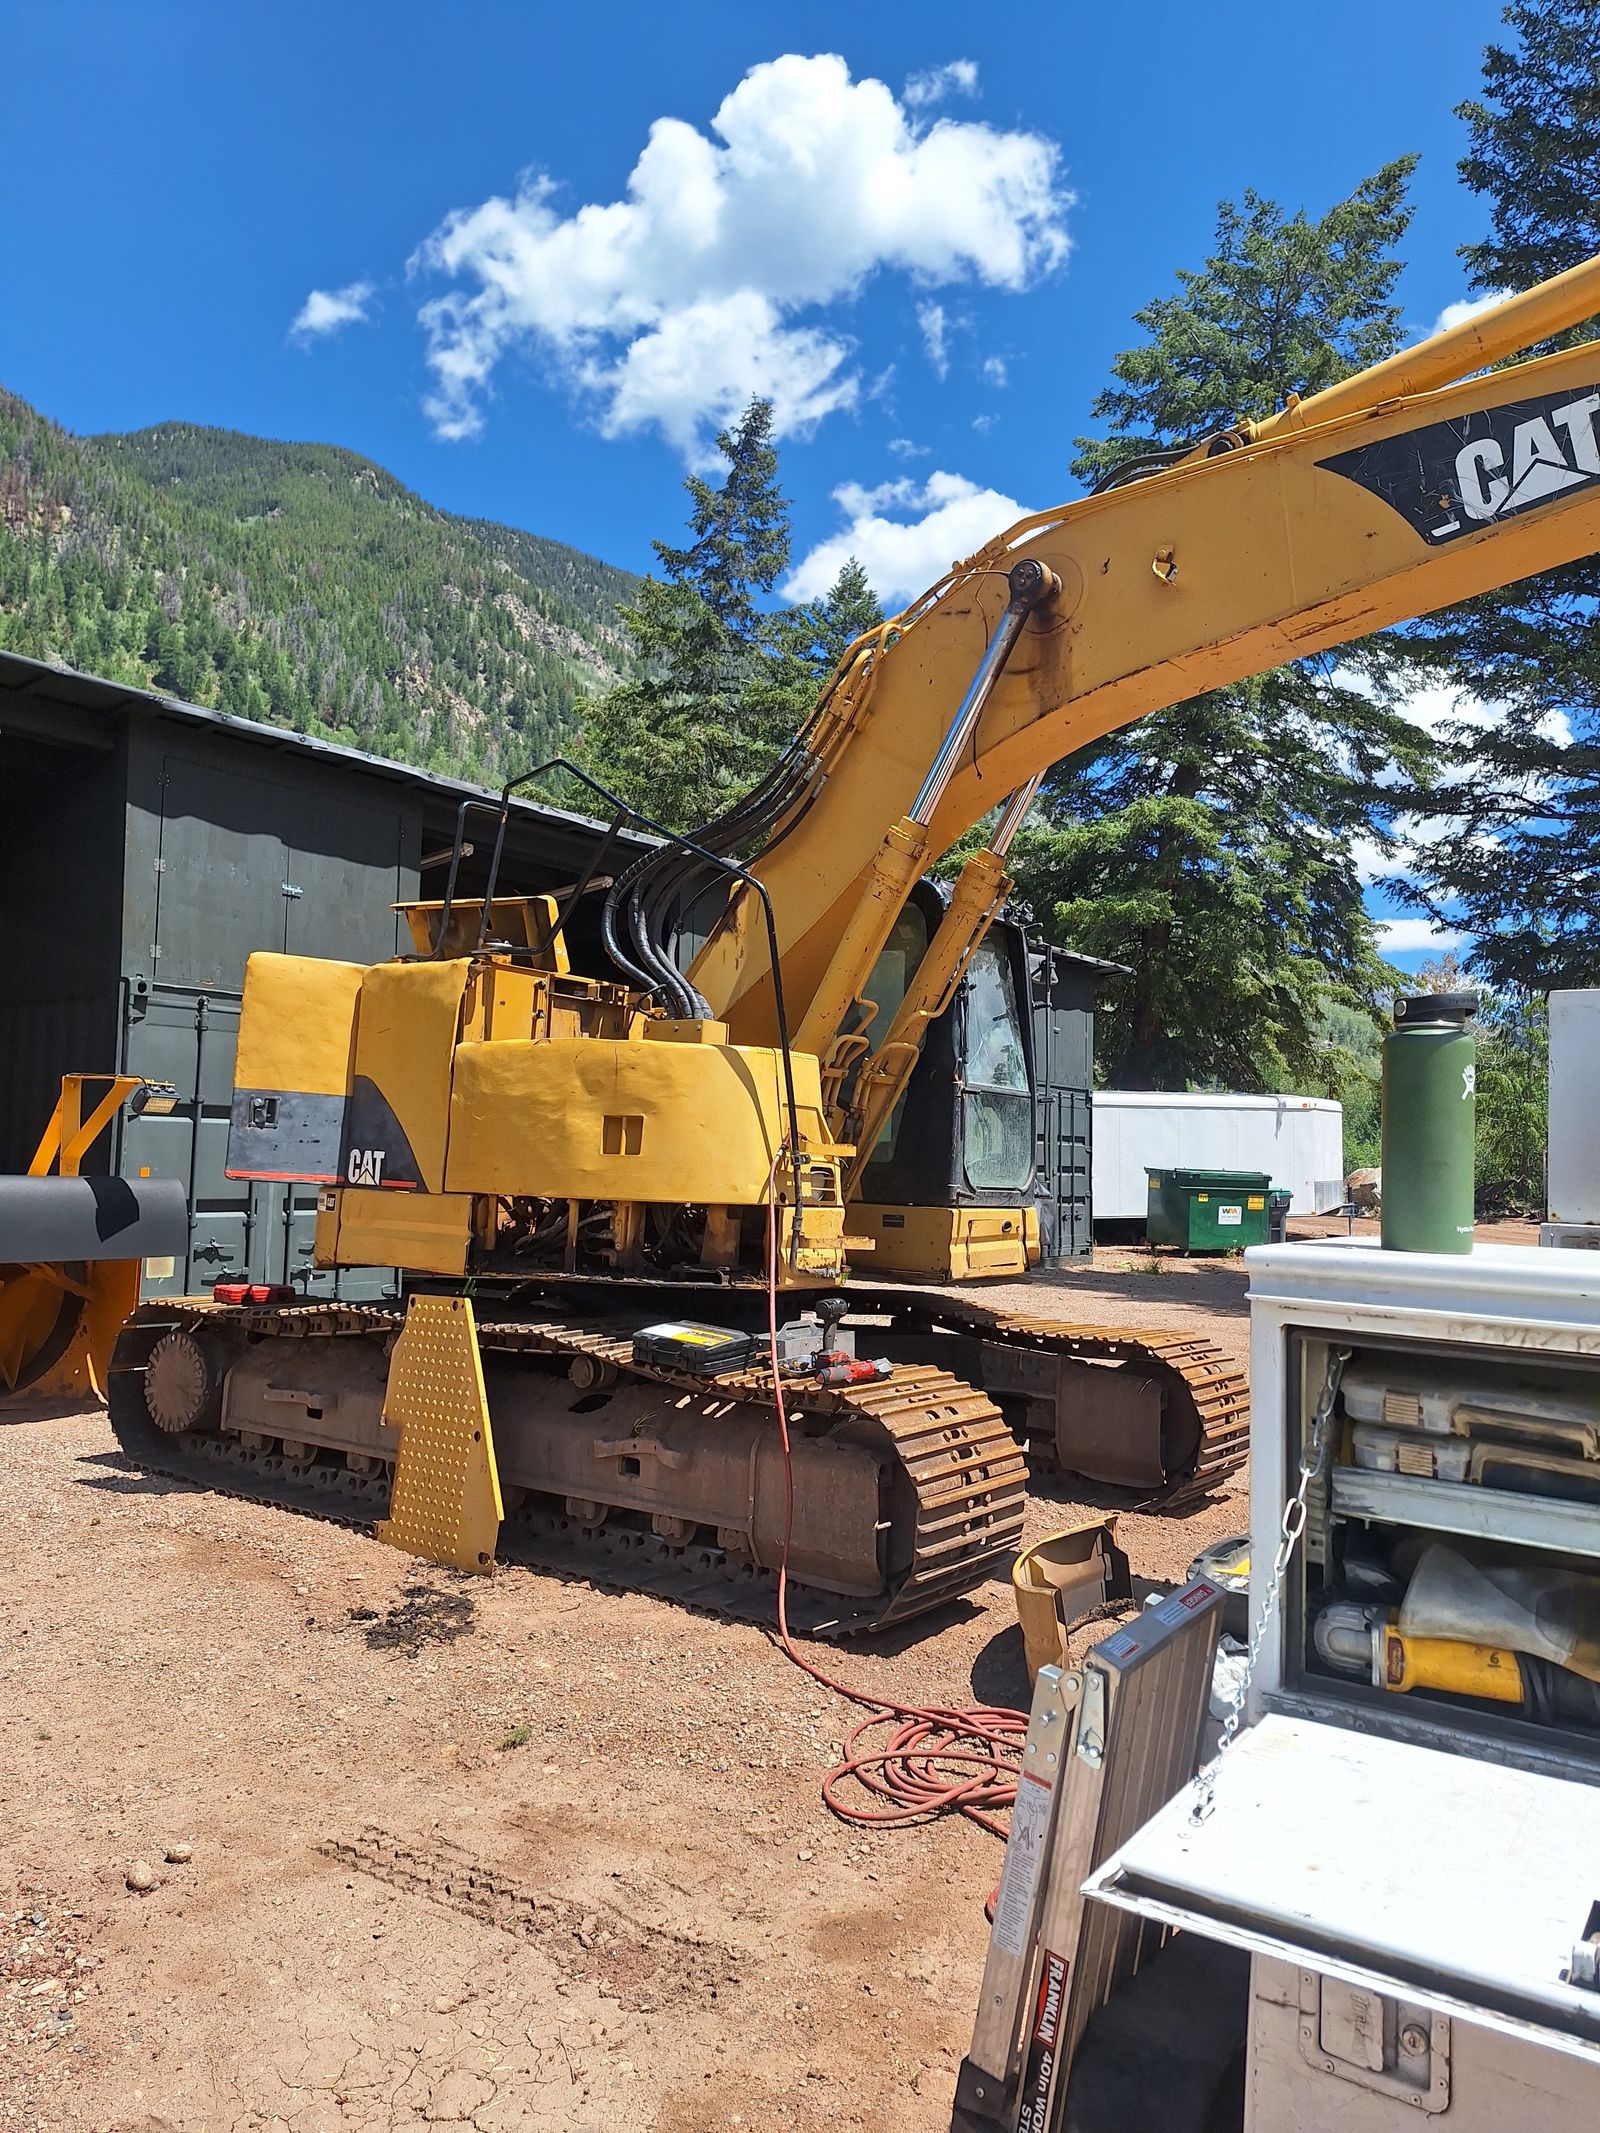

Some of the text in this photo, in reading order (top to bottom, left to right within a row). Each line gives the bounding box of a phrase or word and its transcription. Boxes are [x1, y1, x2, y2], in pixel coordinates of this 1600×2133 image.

[1455, 392, 1600, 521] CAT
[347, 1148, 386, 1186] CAT
[1037, 1956, 1065, 2044] FRANKLIN
